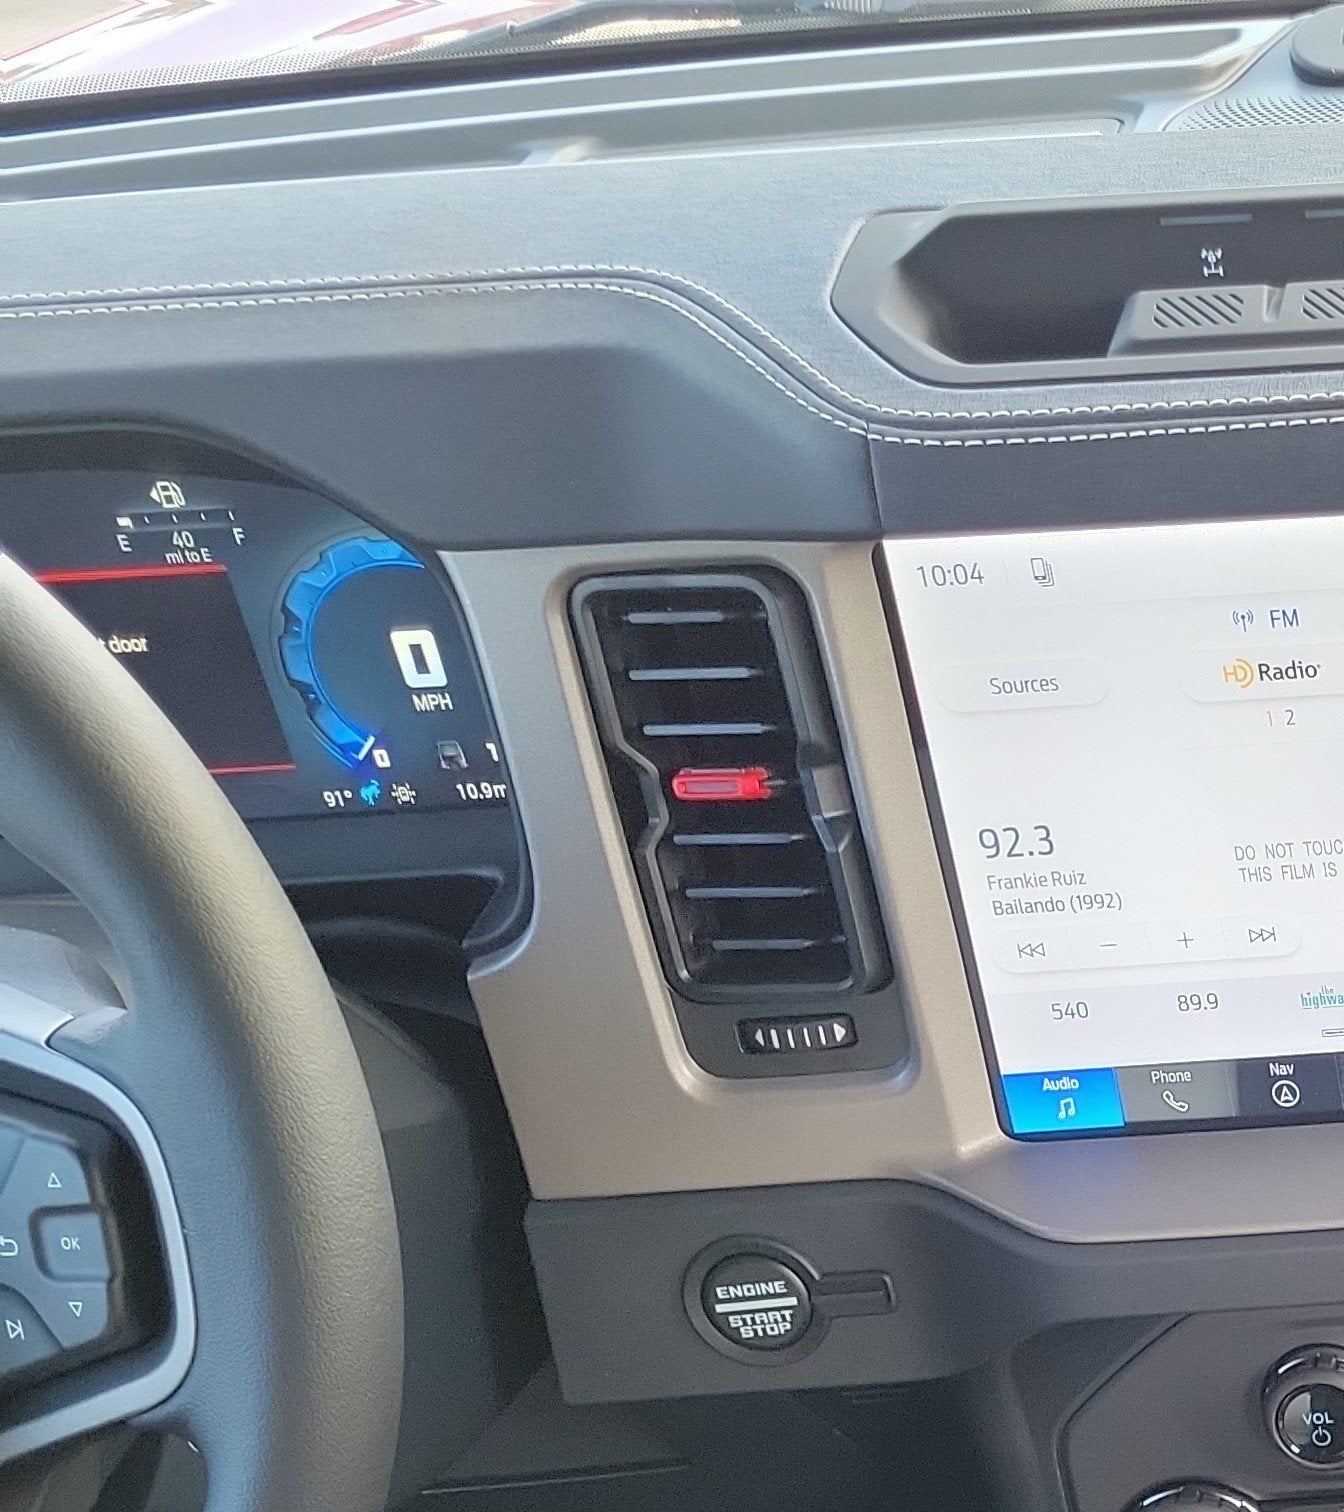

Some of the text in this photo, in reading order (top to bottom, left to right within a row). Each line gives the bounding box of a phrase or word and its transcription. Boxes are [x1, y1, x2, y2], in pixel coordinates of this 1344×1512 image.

[116, 527, 246, 552] E 40 F
[186, 551, 200, 564] to
[200, 548, 214, 562] E
[916, 562, 986, 588] 10:04
[1270, 608, 1300, 628] FM
[108, 634, 148, 654] door
[390, 629, 448, 689] 0
[989, 676, 1059, 696] Sources
[411, 692, 454, 712] MPH
[1284, 708, 1296, 726] 2
[372, 748, 391, 768] 0
[322, 789, 353, 808] 91°
[978, 824, 1055, 860] 92.3
[1234, 844, 1256, 861] DO
[1264, 842, 1294, 860] NOT
[986, 870, 1088, 891] Frankie Ruiz
[1238, 866, 1272, 883] THIS
[1280, 863, 1316, 880] FILM
[1322, 862, 1338, 878] IS
[992, 892, 1123, 916] Bailando (1992)
[1050, 1002, 1089, 1022] 540
[1177, 992, 1220, 1013] 89.9
[1150, 1068, 1192, 1084] Phone
[1268, 1062, 1295, 1077] Nav
[1042, 1076, 1080, 1092] Audio
[60, 1236, 81, 1250] OK
[716, 1280, 788, 1300] ENGINE
[728, 1310, 794, 1328] START
[740, 1322, 792, 1339] STOP
[1302, 1411, 1334, 1426] VOL
